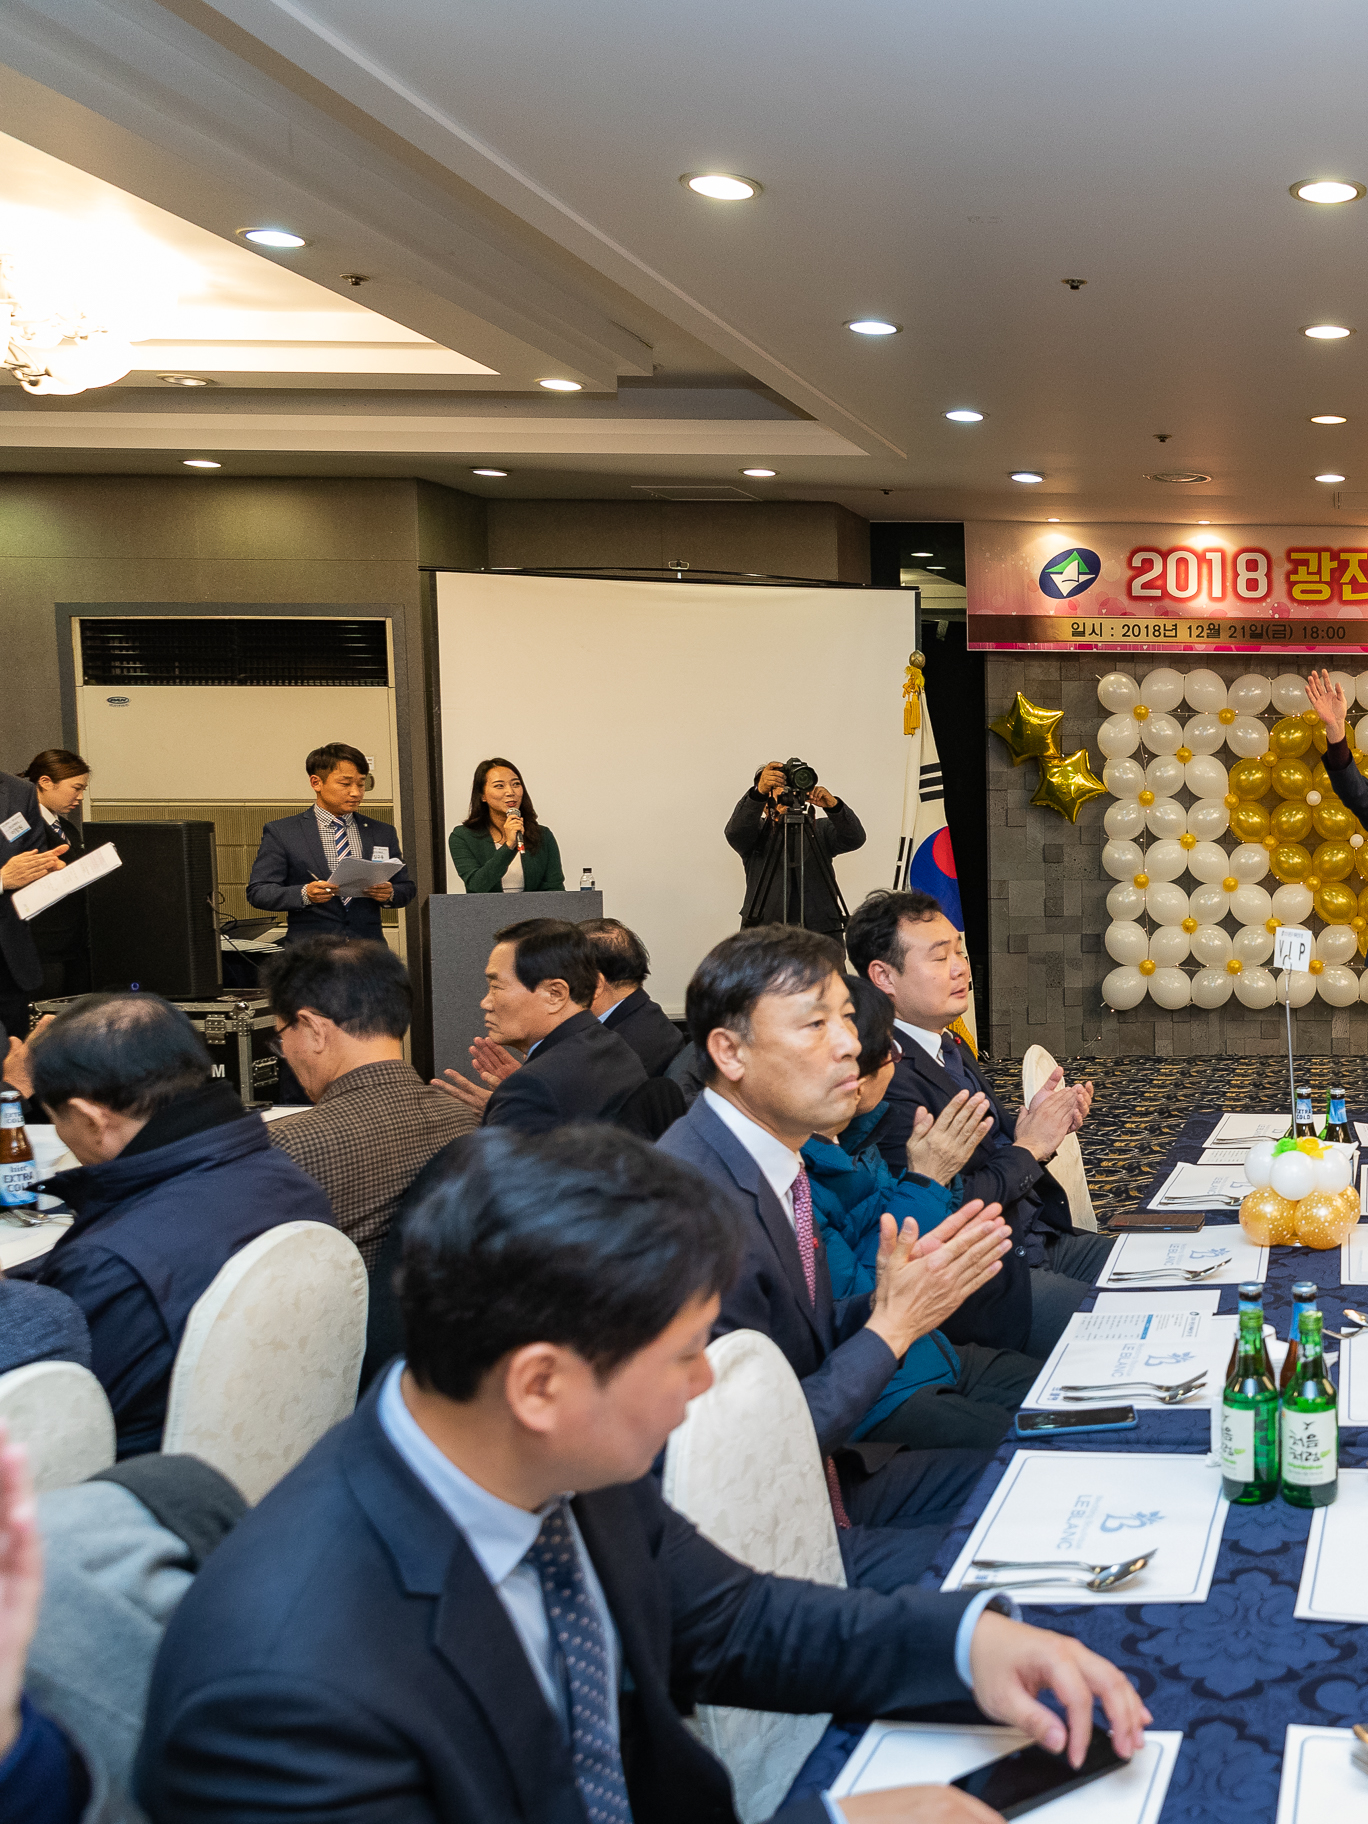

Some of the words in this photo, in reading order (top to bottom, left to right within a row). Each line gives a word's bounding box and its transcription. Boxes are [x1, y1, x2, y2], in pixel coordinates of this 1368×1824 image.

[1131, 550, 1268, 598] 2018
[1071, 621, 1104, 638] 일시
[1121, 622, 1178, 639] 2018년
[1187, 623, 1222, 639] 12월
[1228, 623, 1294, 640] 21일(금)
[1301, 624, 1346, 640] 18:00
[1111, 1351, 1133, 1378] BLANC
[1288, 1429, 1319, 1449] 처음
[1288, 1447, 1321, 1462] 처럼
[1056, 1509, 1086, 1550] BLANC
